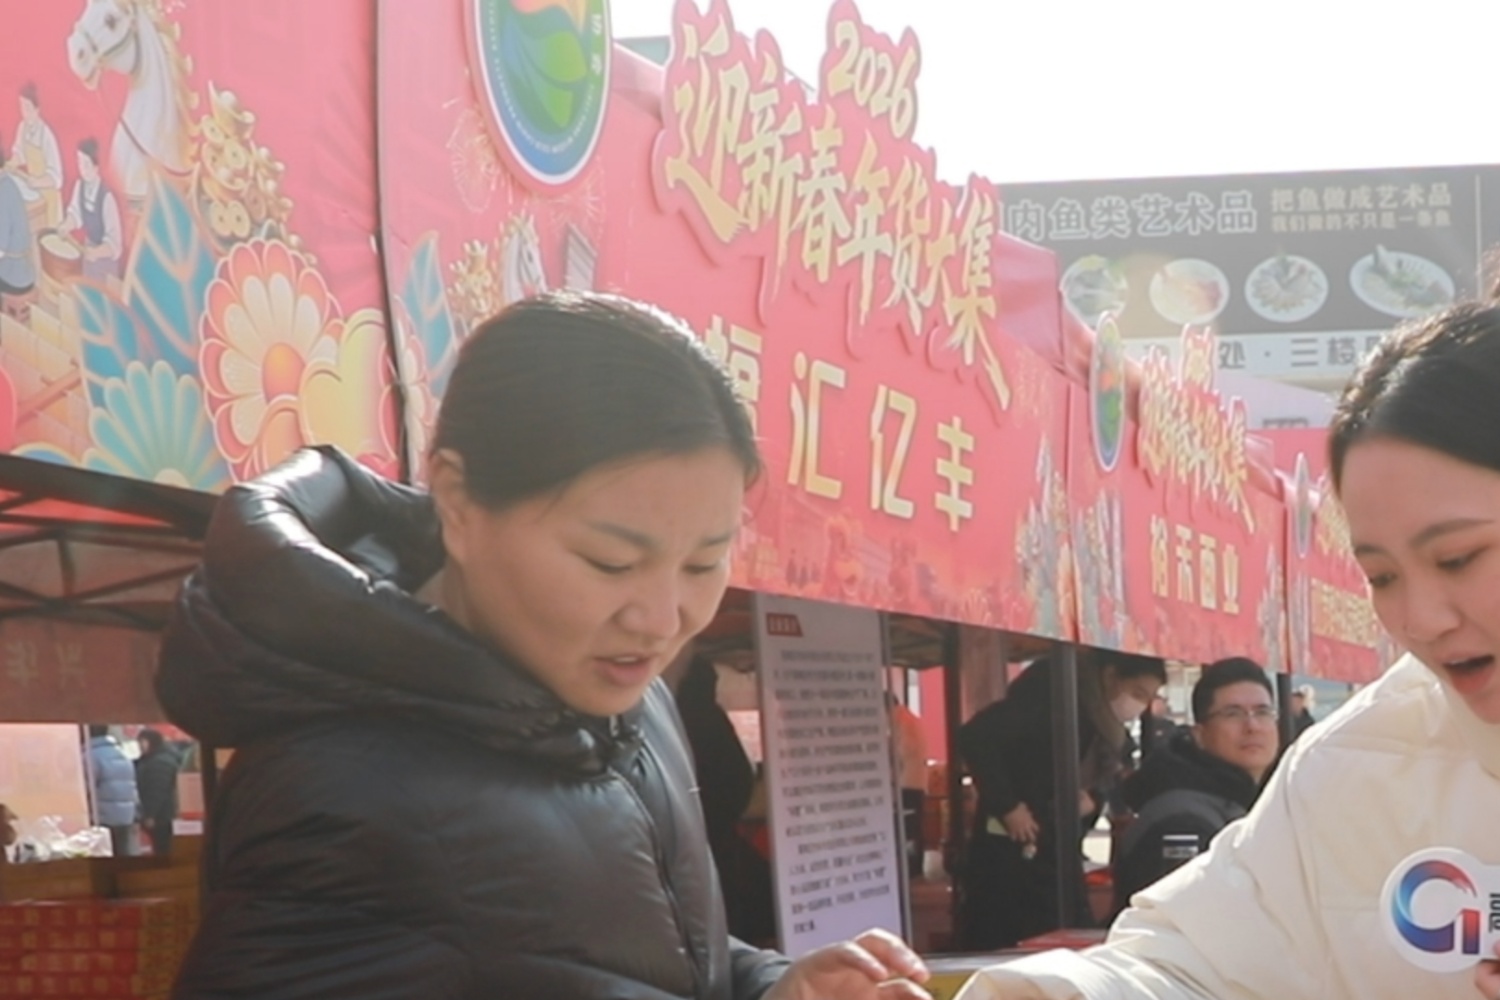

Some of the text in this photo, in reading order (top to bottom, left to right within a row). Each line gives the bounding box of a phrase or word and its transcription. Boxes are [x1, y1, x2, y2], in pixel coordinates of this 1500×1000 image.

[828, 20, 918, 138] 2026
[665, 14, 1011, 410] 迎新春年货大集
[1001, 189, 1258, 242] 内鱼类艺术品
[1271, 182, 1451, 213] 把鱼做成艺术品
